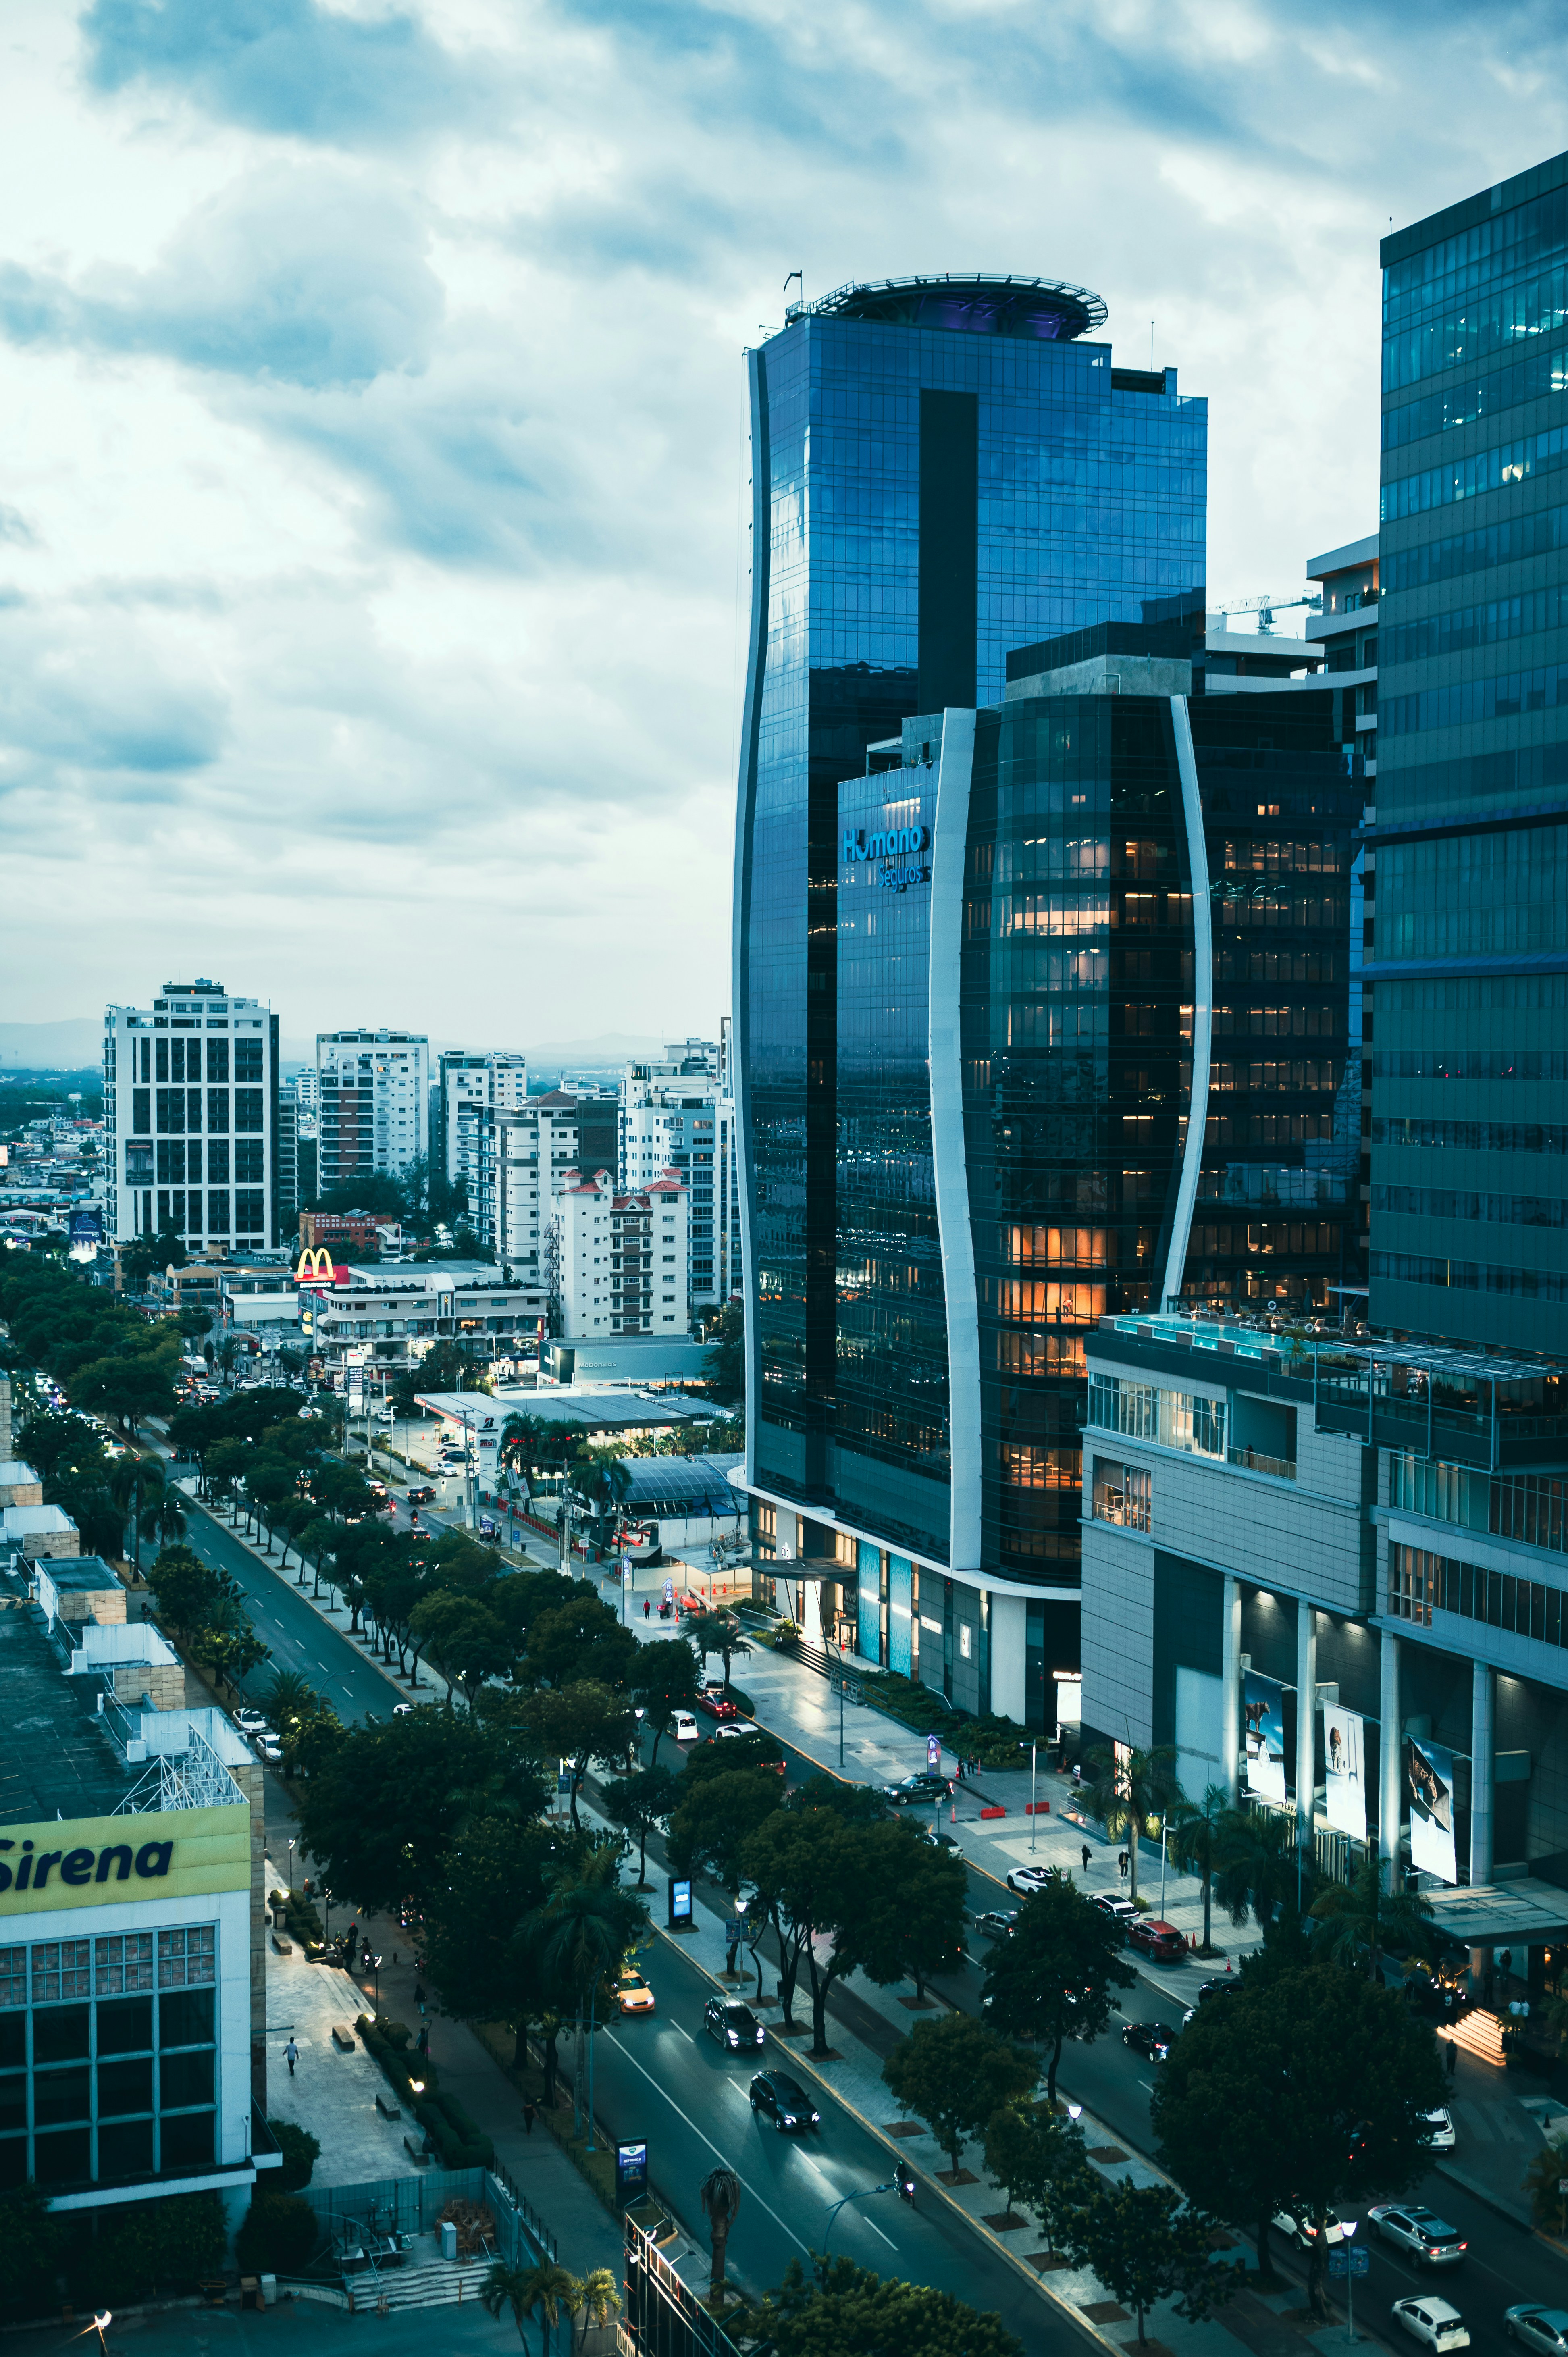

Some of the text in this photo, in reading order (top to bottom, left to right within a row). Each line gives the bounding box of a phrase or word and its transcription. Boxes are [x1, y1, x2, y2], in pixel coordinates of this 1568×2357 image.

[843, 825, 924, 863] Humano
[878, 864, 923, 893] Seguros
[1282, 1803, 1296, 1812] FERR
